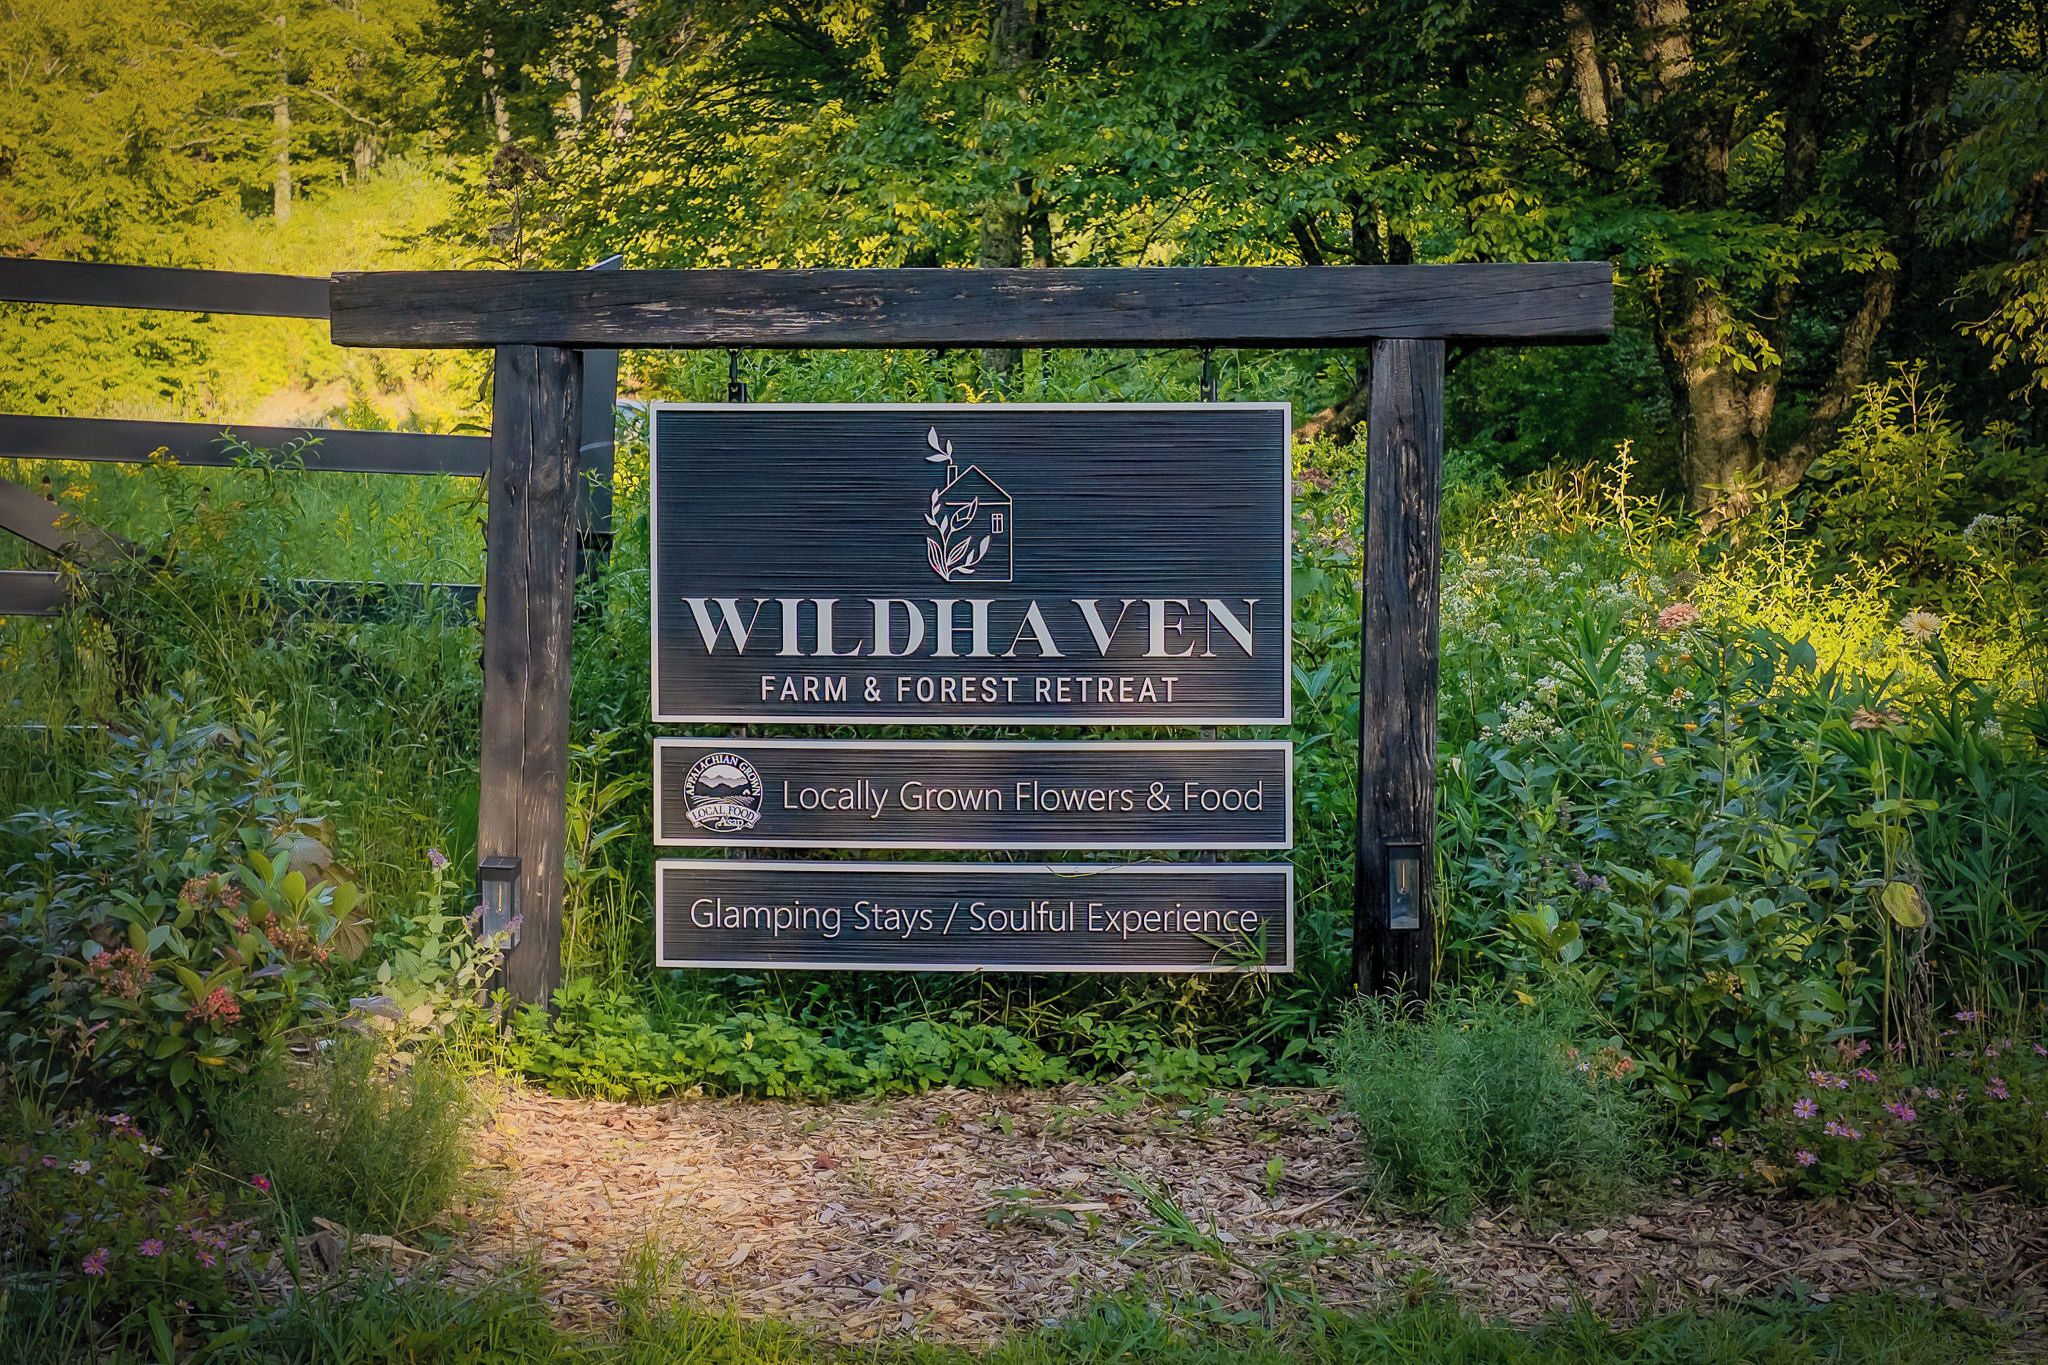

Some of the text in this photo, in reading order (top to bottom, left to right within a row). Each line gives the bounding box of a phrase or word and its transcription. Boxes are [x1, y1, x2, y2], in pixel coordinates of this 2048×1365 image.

[682, 597, 1261, 657] WILDHAVEN
[761, 676, 1179, 703] FARM & FOREST RETREAT
[686, 755, 760, 796] APPALACHIAN GROWN
[692, 805, 755, 820] LOCAL FOOD
[783, 780, 1264, 819] Locally Grown Flowers & Food
[690, 898, 1258, 940] Glamping Stays / Soulful Experience
